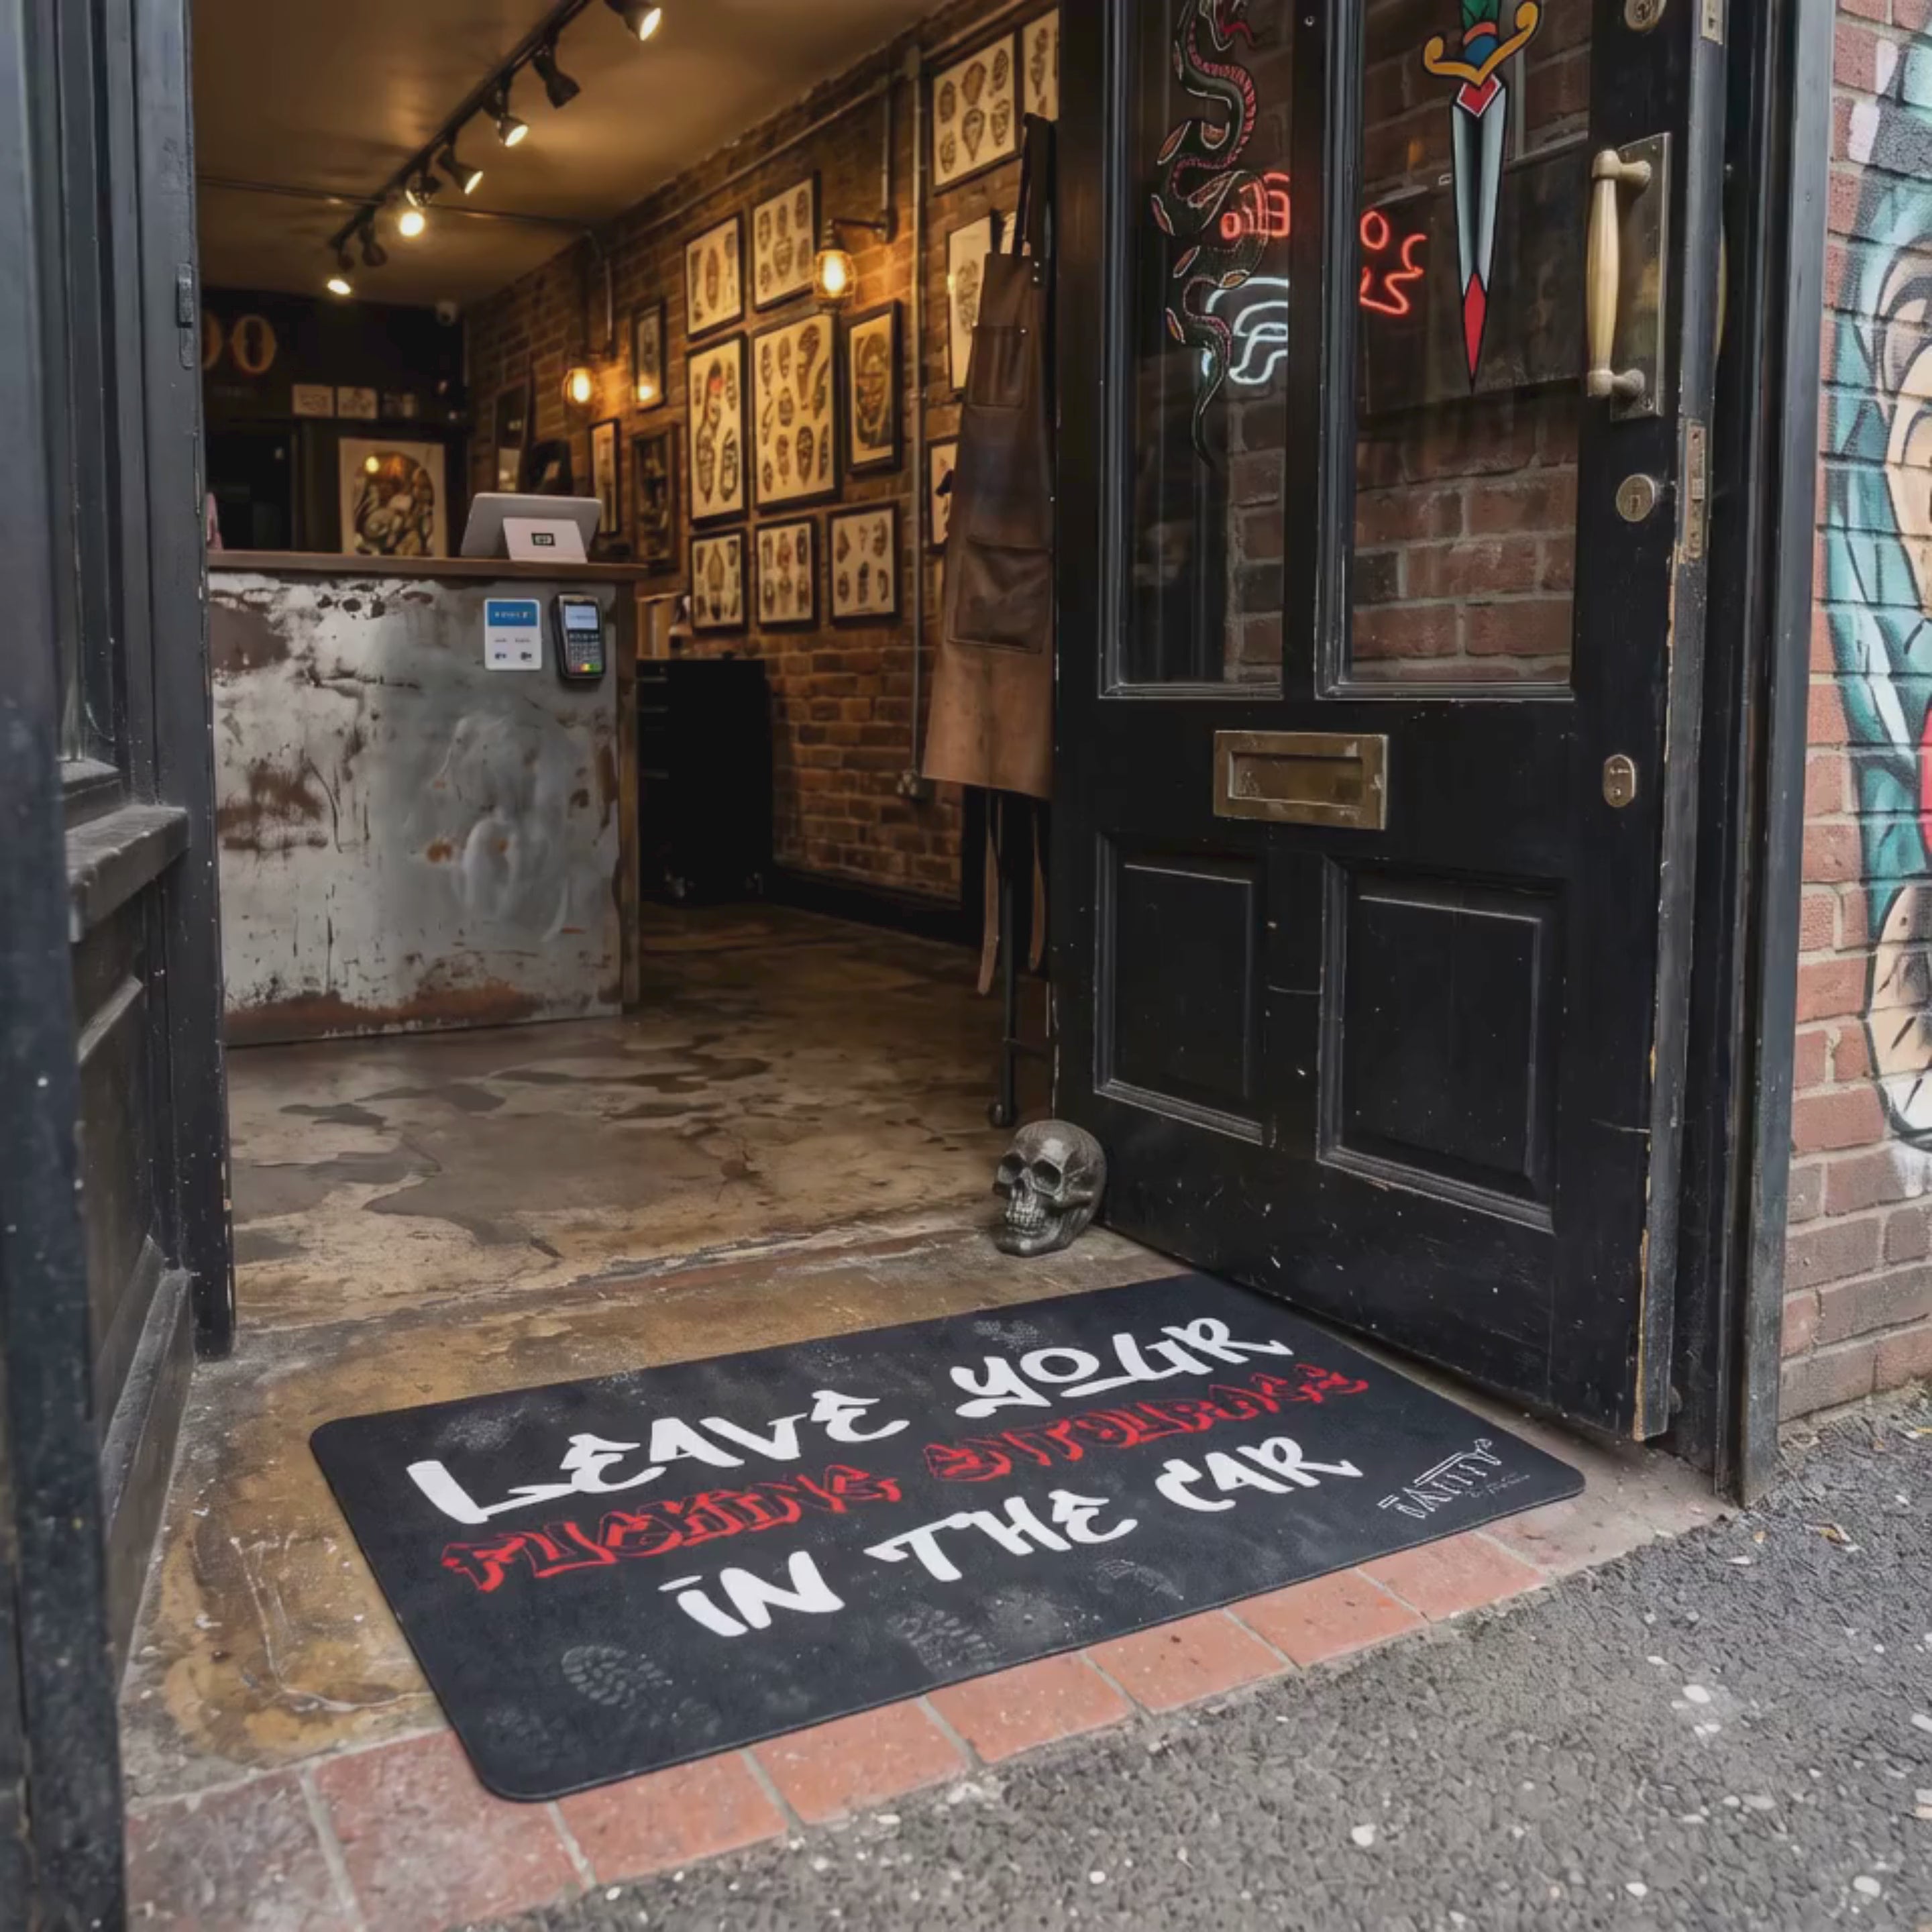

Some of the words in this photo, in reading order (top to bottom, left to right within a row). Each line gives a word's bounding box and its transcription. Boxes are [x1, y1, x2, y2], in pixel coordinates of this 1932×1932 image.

[406, 1390, 910, 1524] LEAVE
[950, 1318, 1293, 1417] YOUR
[441, 1464, 902, 1593] FUCKING
[922, 1363, 1368, 1482] ENTOURAGE
[657, 1550, 845, 1637] IN
[863, 1489, 1139, 1582] THE
[1155, 1436, 1363, 1512] CAR
